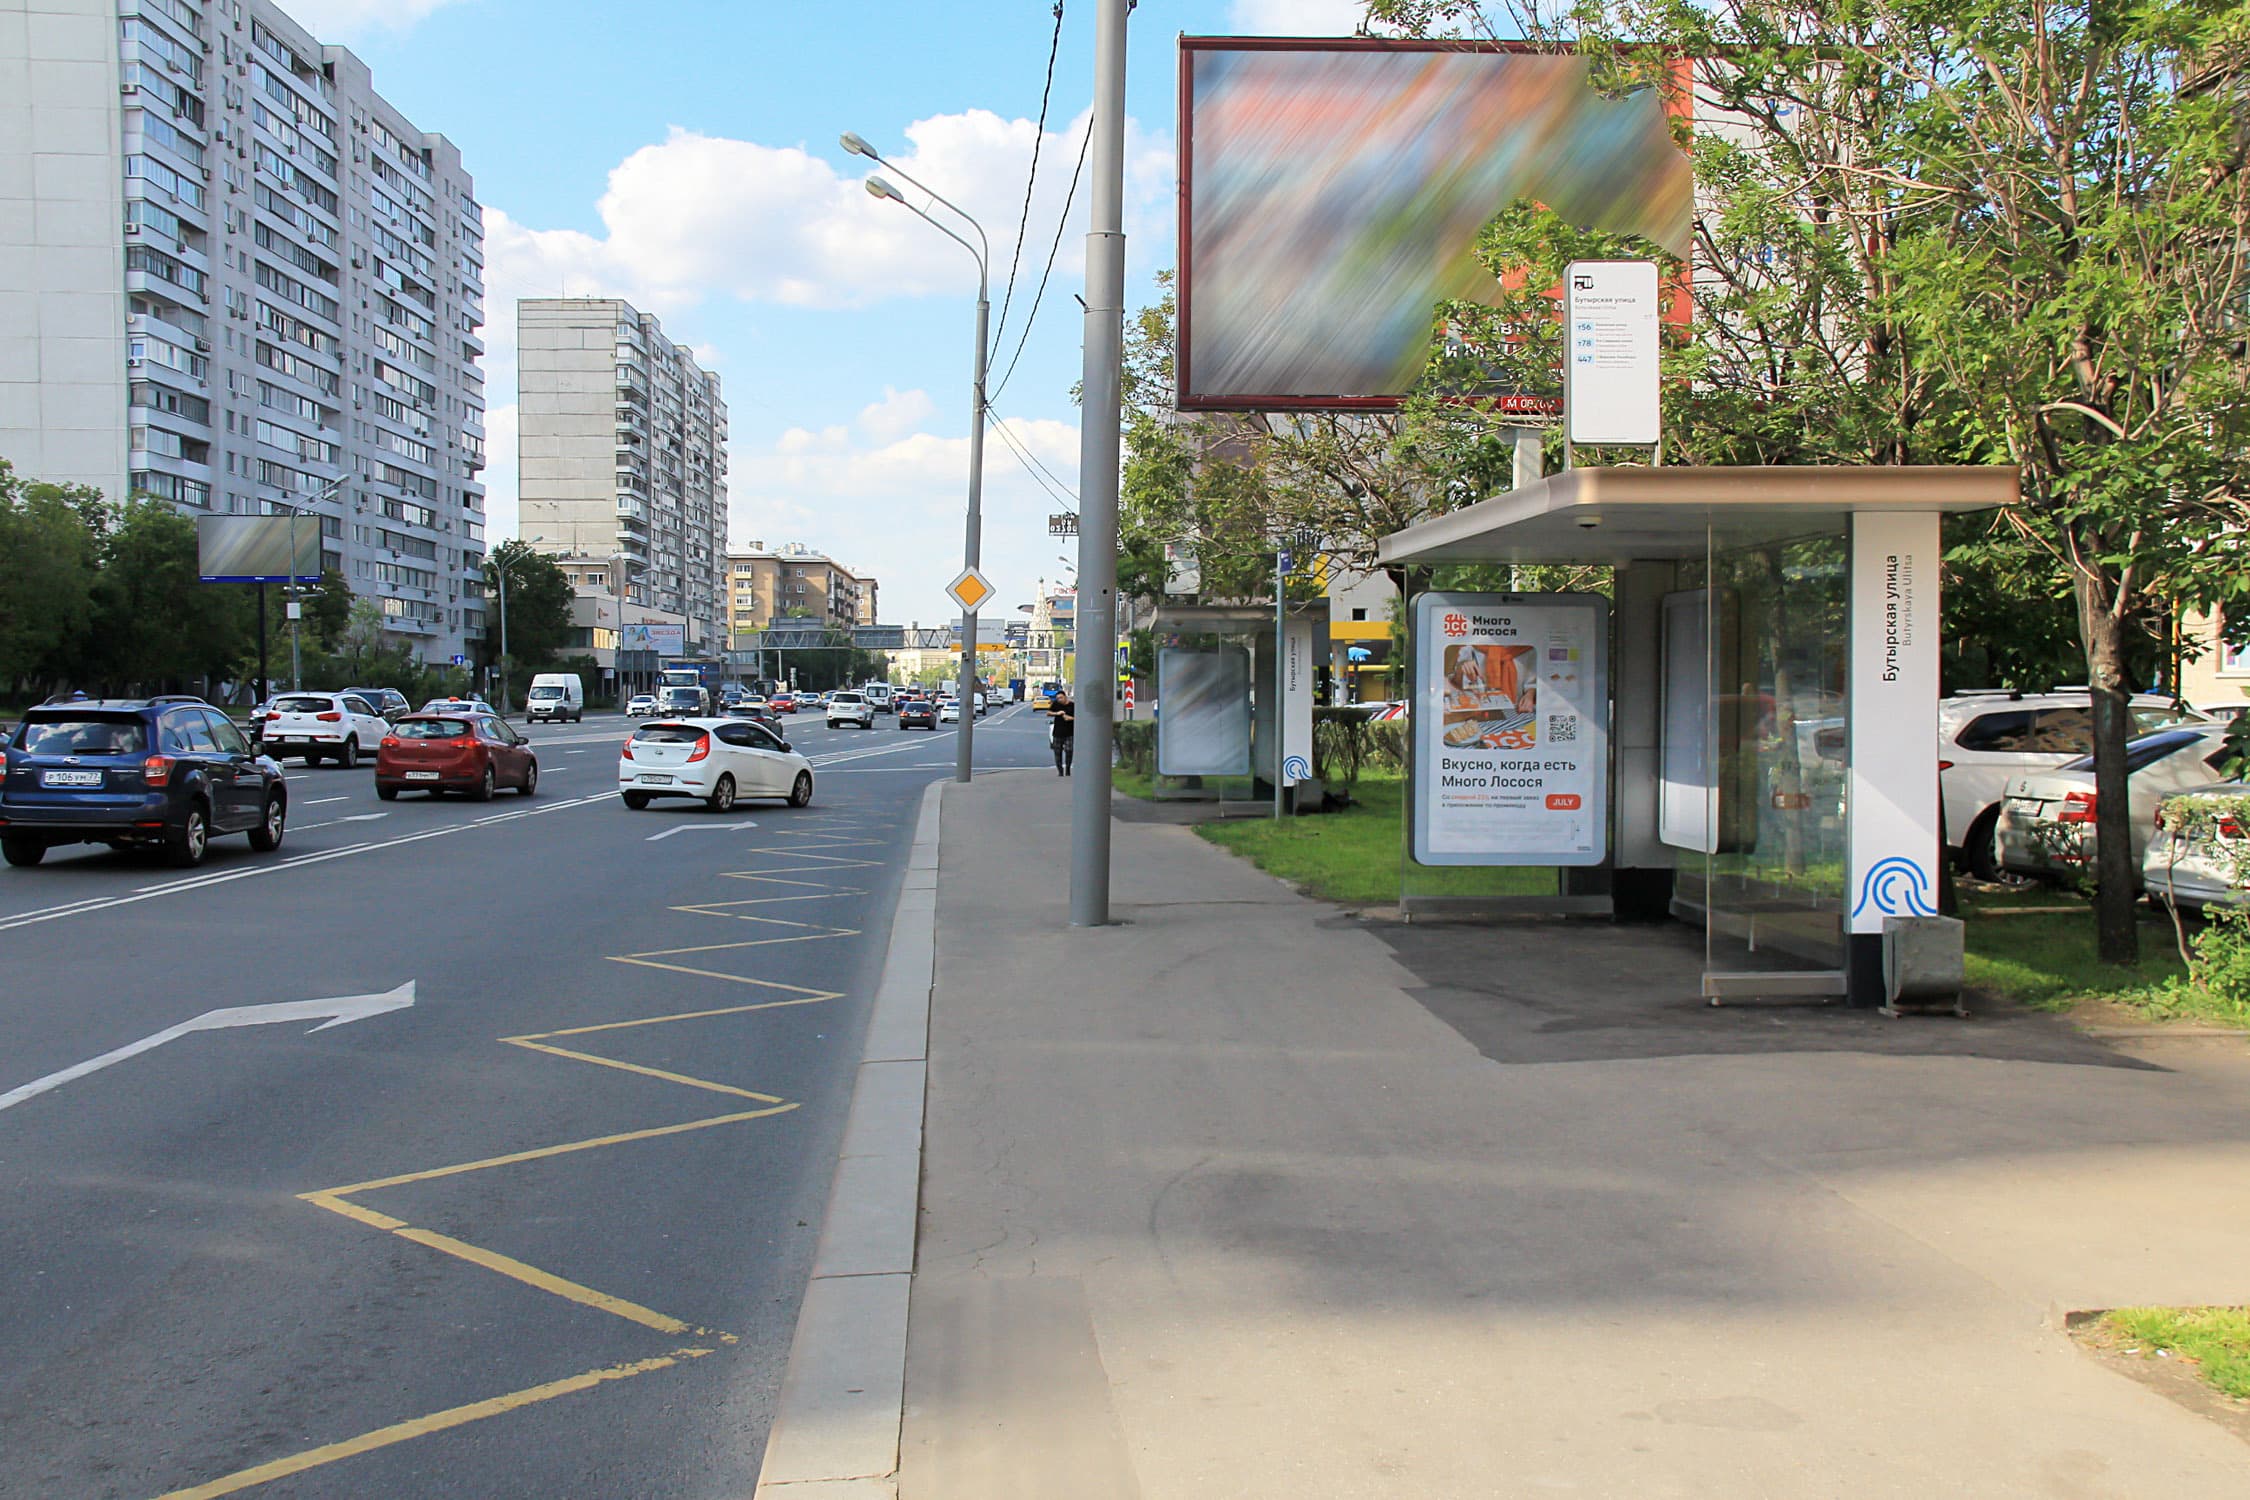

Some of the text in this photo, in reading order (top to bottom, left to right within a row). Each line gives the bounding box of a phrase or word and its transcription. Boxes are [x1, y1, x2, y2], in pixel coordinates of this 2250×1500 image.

[1575, 296, 1613, 304] Бутырская
[1903, 554, 1913, 646] Butyrskaya Ulitsa
[1472, 616, 1511, 625] Много
[1883, 555, 1900, 681] Бутырская улица
[1472, 628, 1517, 636] лосося
[1442, 758, 1576, 772] Вкусно, когда есть
[1442, 775, 1543, 787] Много Лосося
[1552, 798, 1574, 806] JULY
